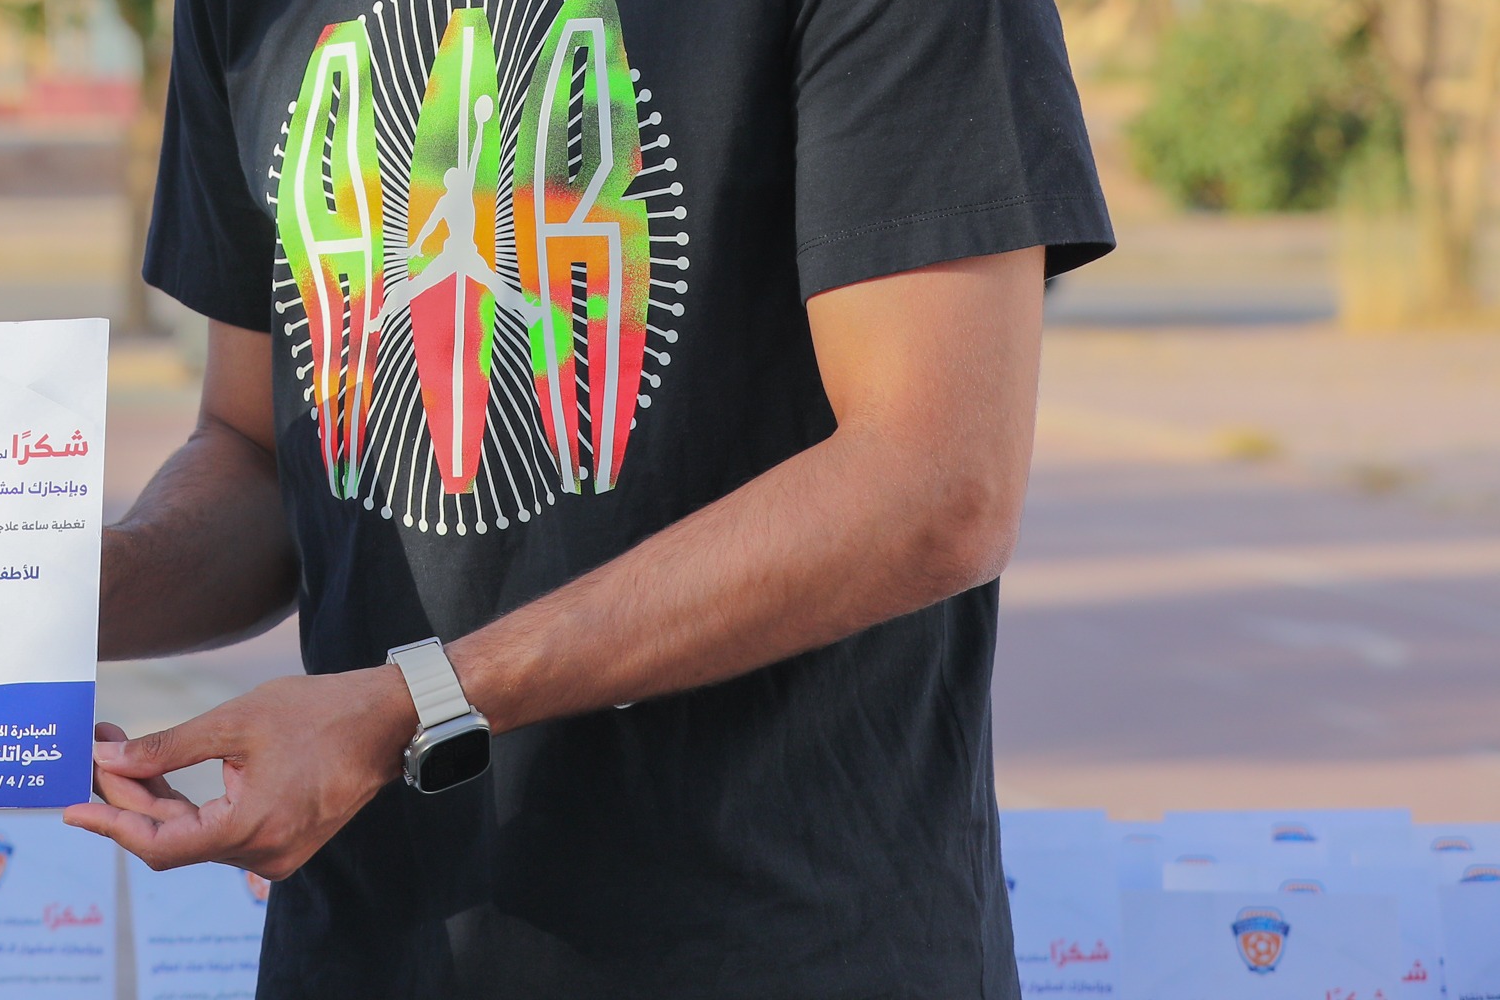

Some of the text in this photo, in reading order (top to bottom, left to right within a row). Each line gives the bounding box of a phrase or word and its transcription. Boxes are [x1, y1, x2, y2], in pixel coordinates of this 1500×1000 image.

[27, 480, 88, 498] وبإنجازك
[21, 519, 49, 531] ساعة
[51, 518, 86, 533] تغطية
[10, 723, 57, 740] المبادرة
[27, 774, 45, 787] 26
